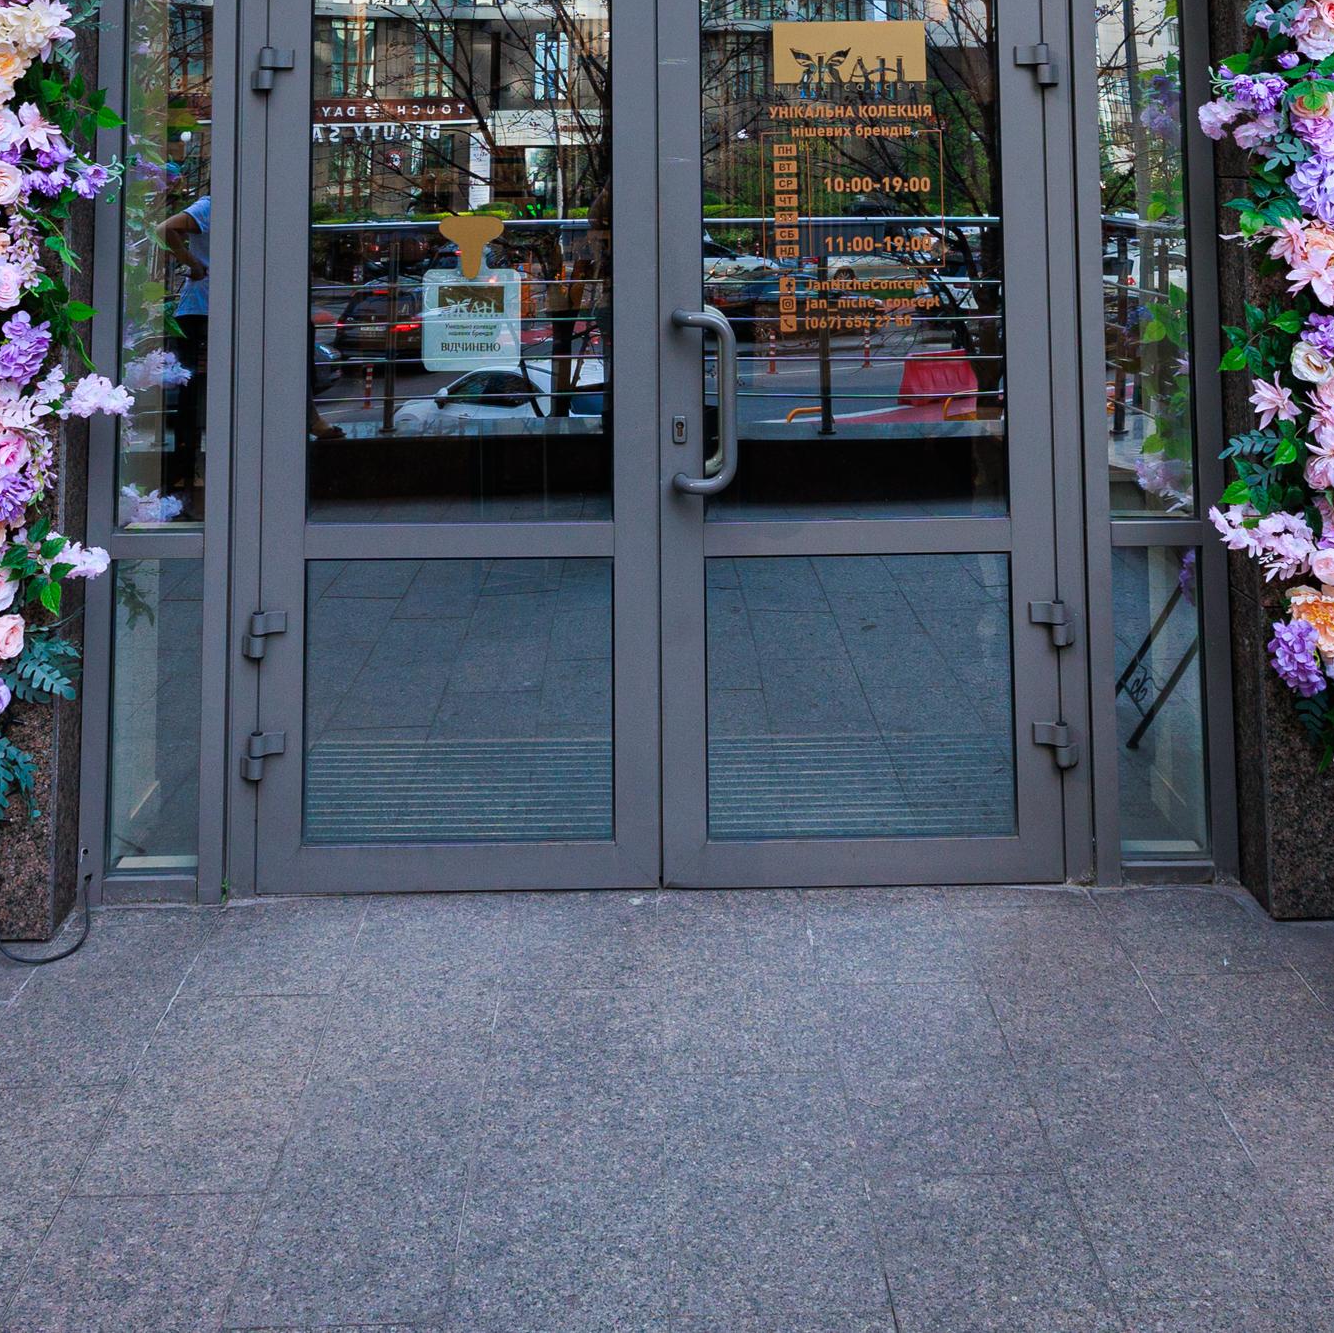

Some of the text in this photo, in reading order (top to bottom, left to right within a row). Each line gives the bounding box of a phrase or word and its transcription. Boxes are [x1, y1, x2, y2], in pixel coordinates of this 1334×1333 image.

[843, 82, 927, 91] CONCEPT
[769, 103, 933, 119] УНІКАЛЬНА КОЛЕКЦІЯ
[790, 124, 912, 138] нішевих брендів
[777, 146, 793, 155] ПН
[778, 163, 792, 172] ВТ
[778, 179, 793, 188] СР
[823, 176, 931, 193] 10:00-19:00
[778, 196, 793, 205] ЧТ
[779, 230, 795, 239] СБ
[825, 235, 932, 252] 11:00-19:00
[779, 246, 795, 256] НД
[805, 295, 941, 312] jan_niche_concept
[805, 315, 842, 330] (067)
[441, 342, 501, 353] ВІДЧИНЕНО
